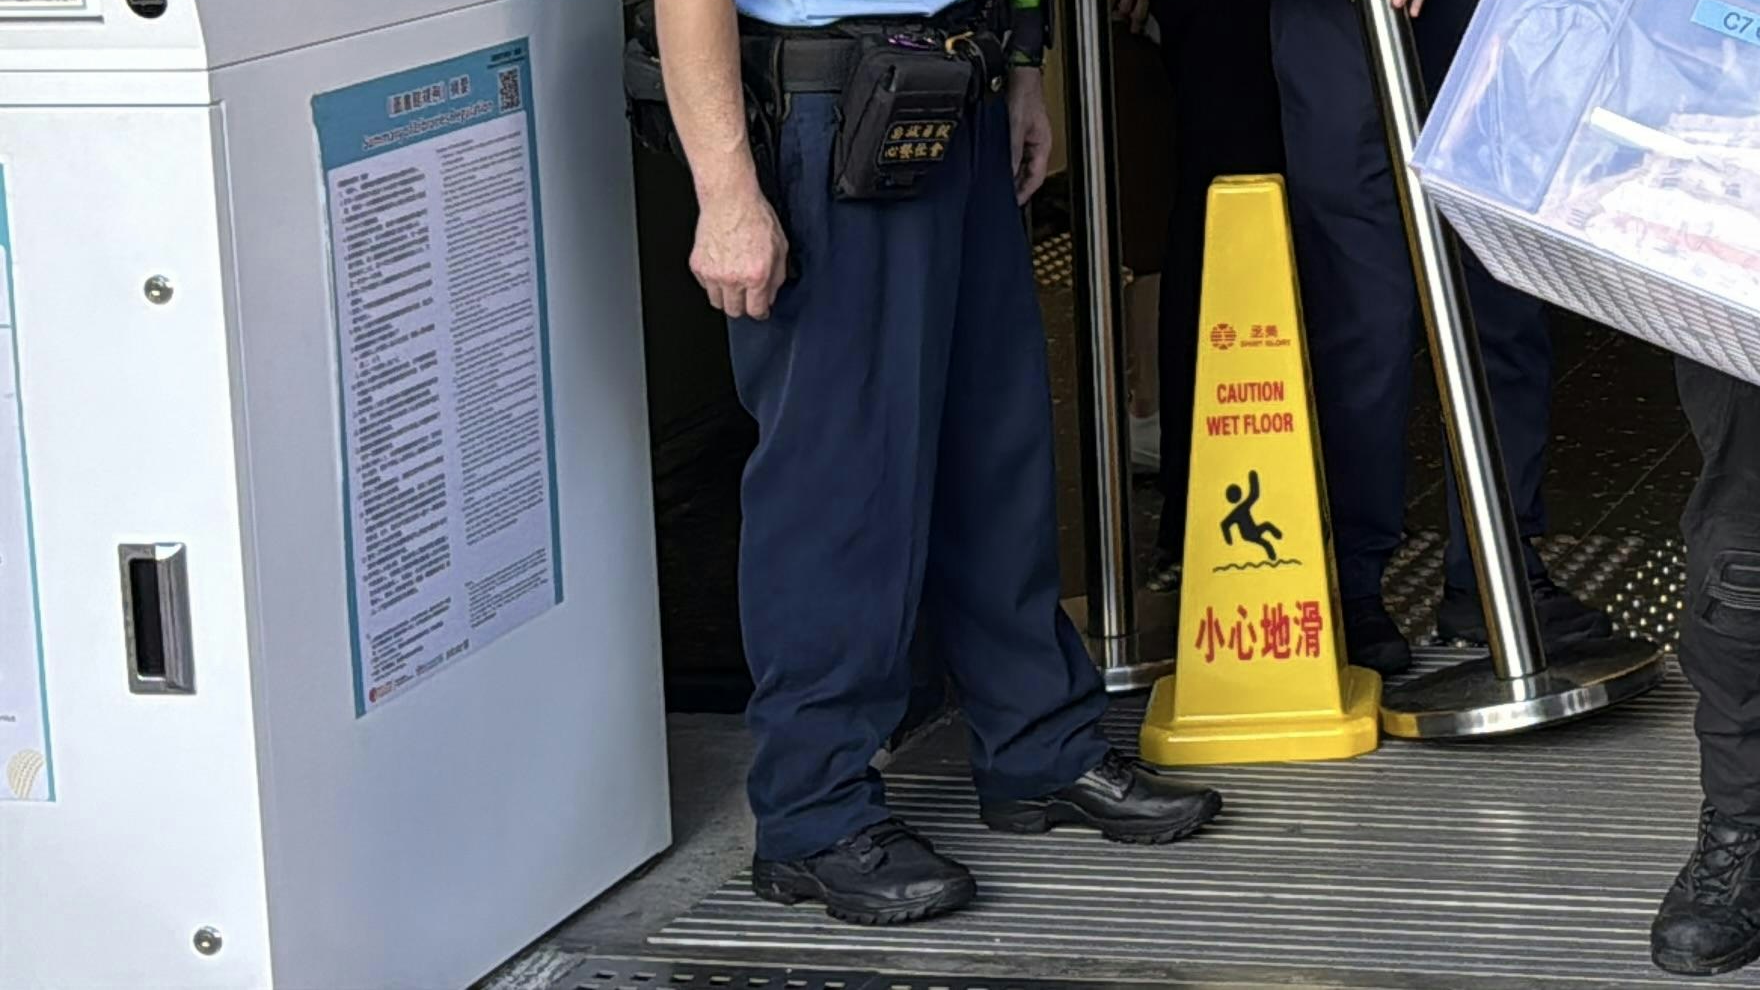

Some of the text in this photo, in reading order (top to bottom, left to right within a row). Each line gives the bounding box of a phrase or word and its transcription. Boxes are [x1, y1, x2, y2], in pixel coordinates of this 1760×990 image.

[1723, 11, 1754, 35] C7
[1216, 380, 1284, 405] CAUTION
[1206, 412, 1293, 436] WET FLOOR
[1194, 600, 1323, 663] 小心地滑
